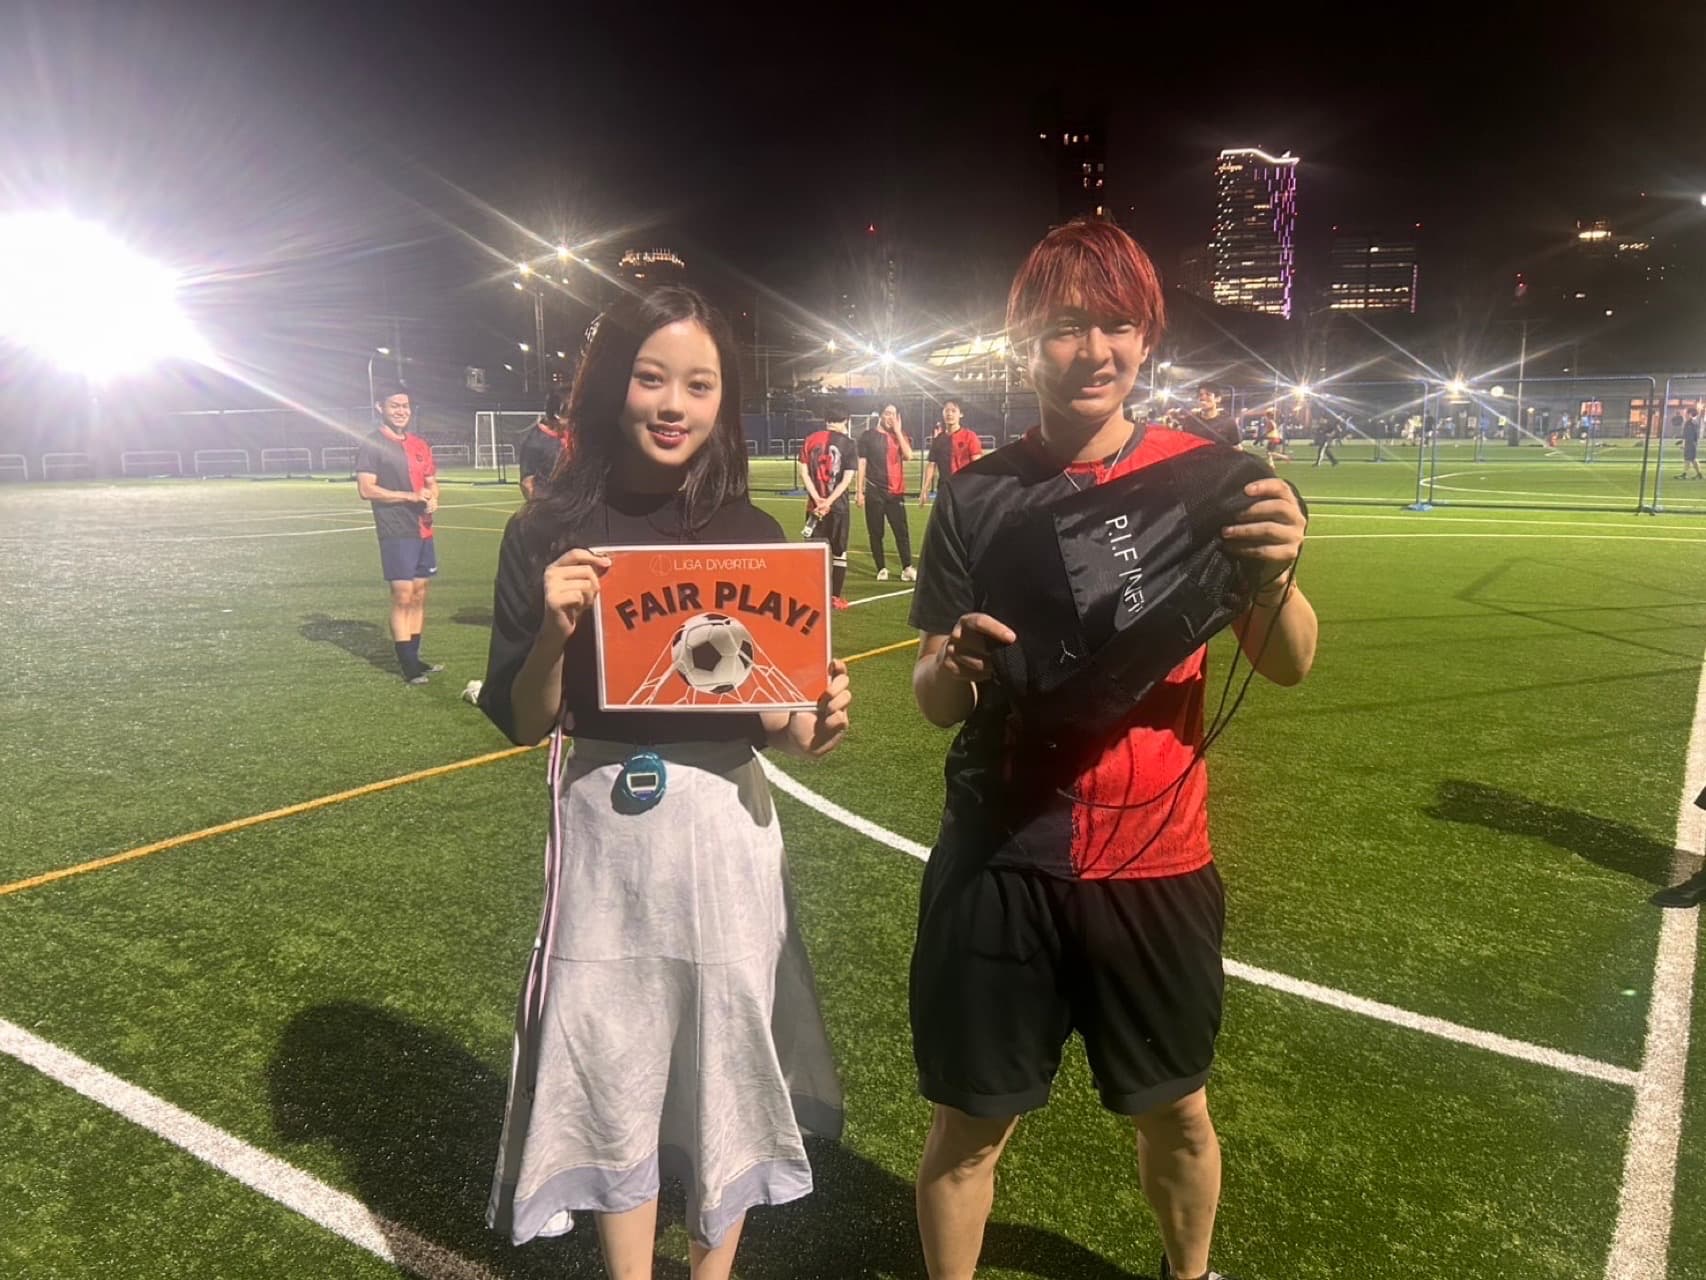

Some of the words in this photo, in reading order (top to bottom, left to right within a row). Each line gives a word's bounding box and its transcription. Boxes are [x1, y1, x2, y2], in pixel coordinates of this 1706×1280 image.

[1105, 514, 1138, 561] P.I.F
[615, 582, 702, 631] FAIR
[714, 581, 820, 636] PLAY!
